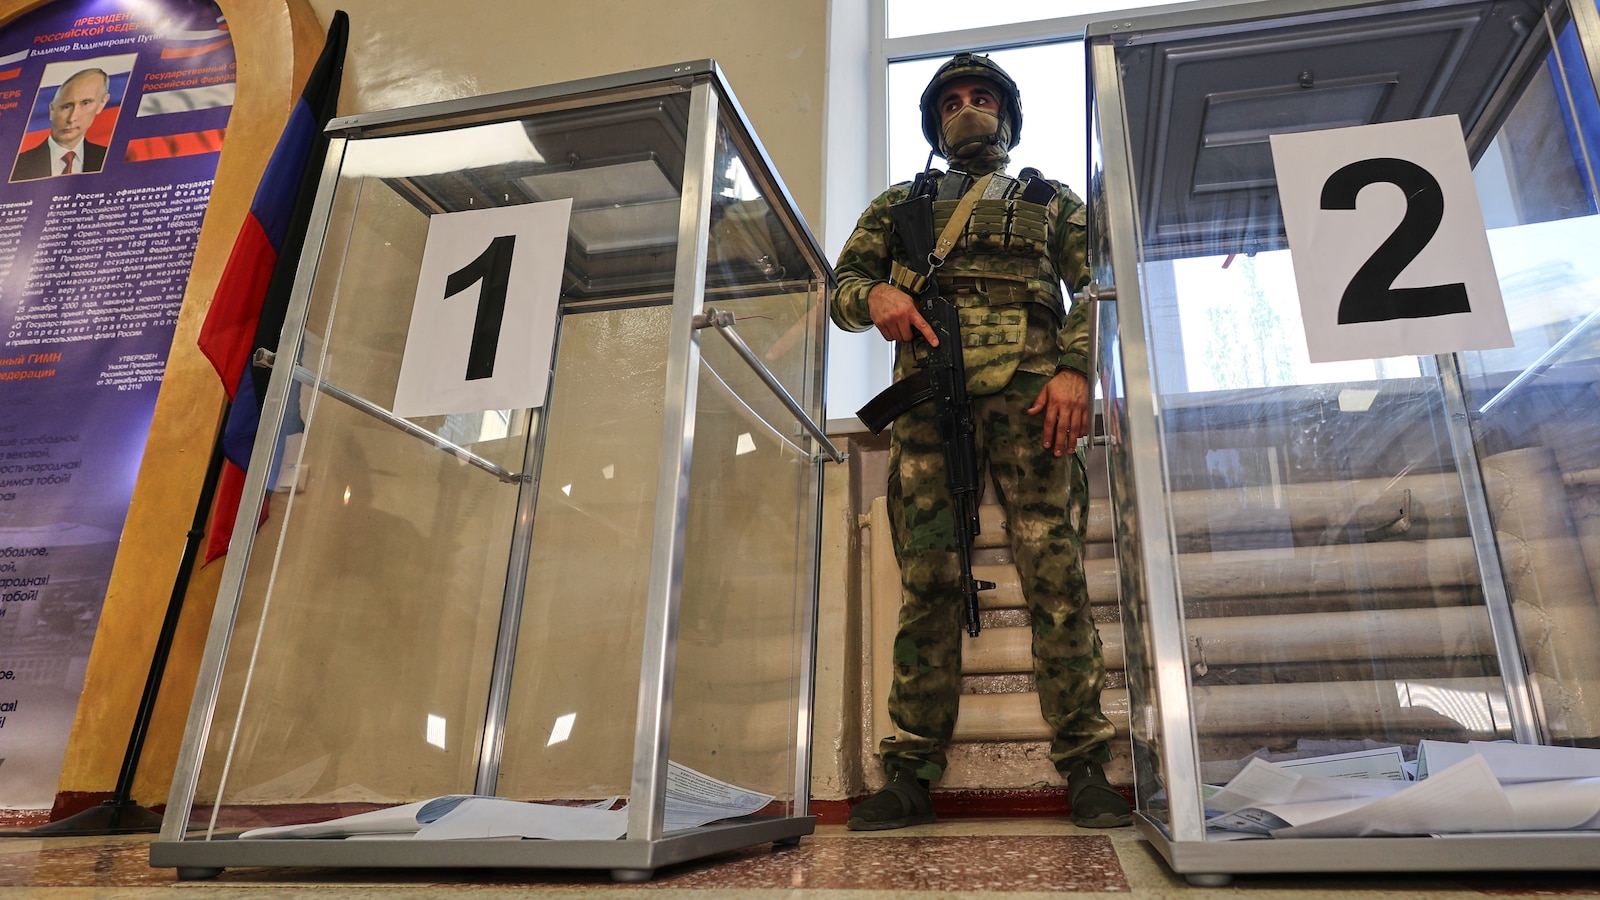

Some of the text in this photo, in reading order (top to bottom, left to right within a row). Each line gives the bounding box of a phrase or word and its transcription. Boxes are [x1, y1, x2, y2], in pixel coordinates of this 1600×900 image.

[33, 25, 105, 43] РОССИЙСКОЙ
[30, 45, 70, 57] Владимир
[72, 37, 136, 50] Владимирович
[144, 63, 227, 81] Государственный
[142, 77, 198, 91] Российской
[116, 184, 172, 196] официальный
[49, 201, 92, 210] символ
[99, 192, 167, 205] Российской
[81, 205, 125, 214] Российского
[1320, 157, 1472, 325] 2
[56, 275, 120, 286] символизирует
[444, 235, 516, 381] 1
[27, 326, 90, 337] определяет
[96, 321, 147, 331] правовое
[27, 352, 62, 364] ГИМН
[26, 460, 82, 474] народная!
[36, 473, 72, 485] тобой!
[2, 589, 39, 602] тобой!
